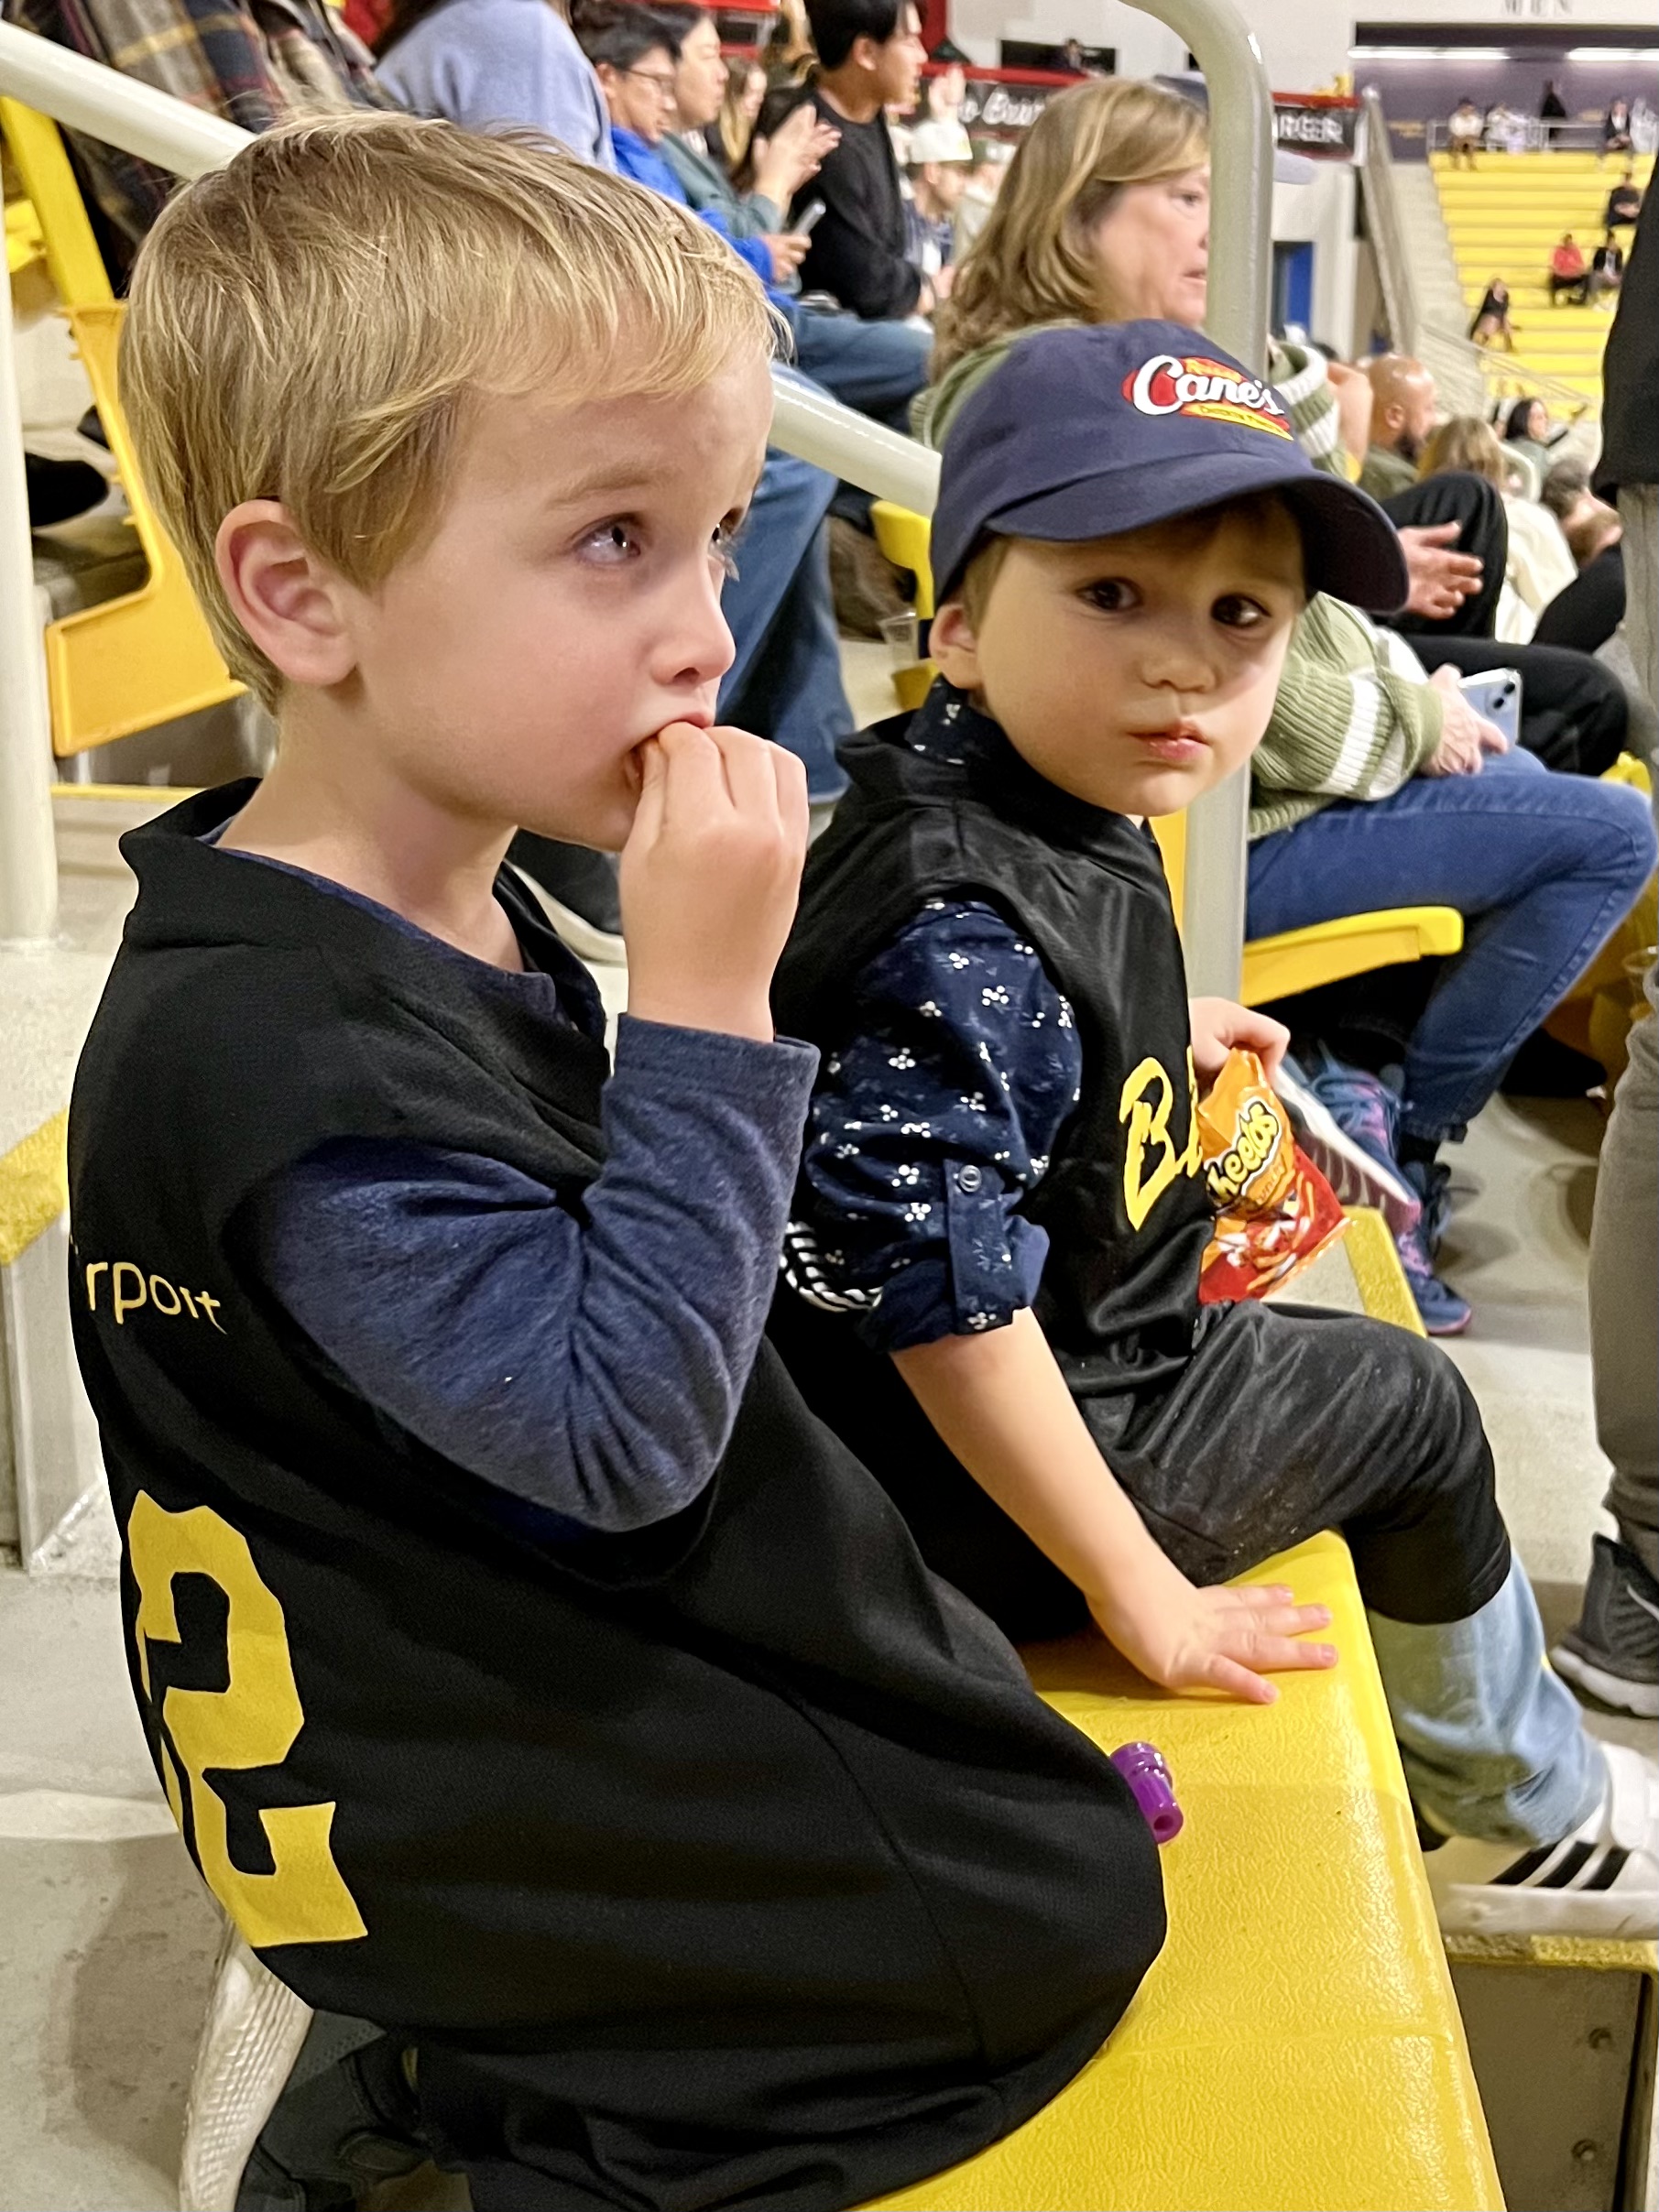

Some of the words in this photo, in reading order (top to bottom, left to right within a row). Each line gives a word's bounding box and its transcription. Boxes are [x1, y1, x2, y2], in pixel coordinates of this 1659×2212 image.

[1132, 354, 1285, 416] Cane's
[1206, 1099, 1280, 1210] heetos
[85, 1260, 228, 1335] rport
[127, 1489, 368, 1948] 2
